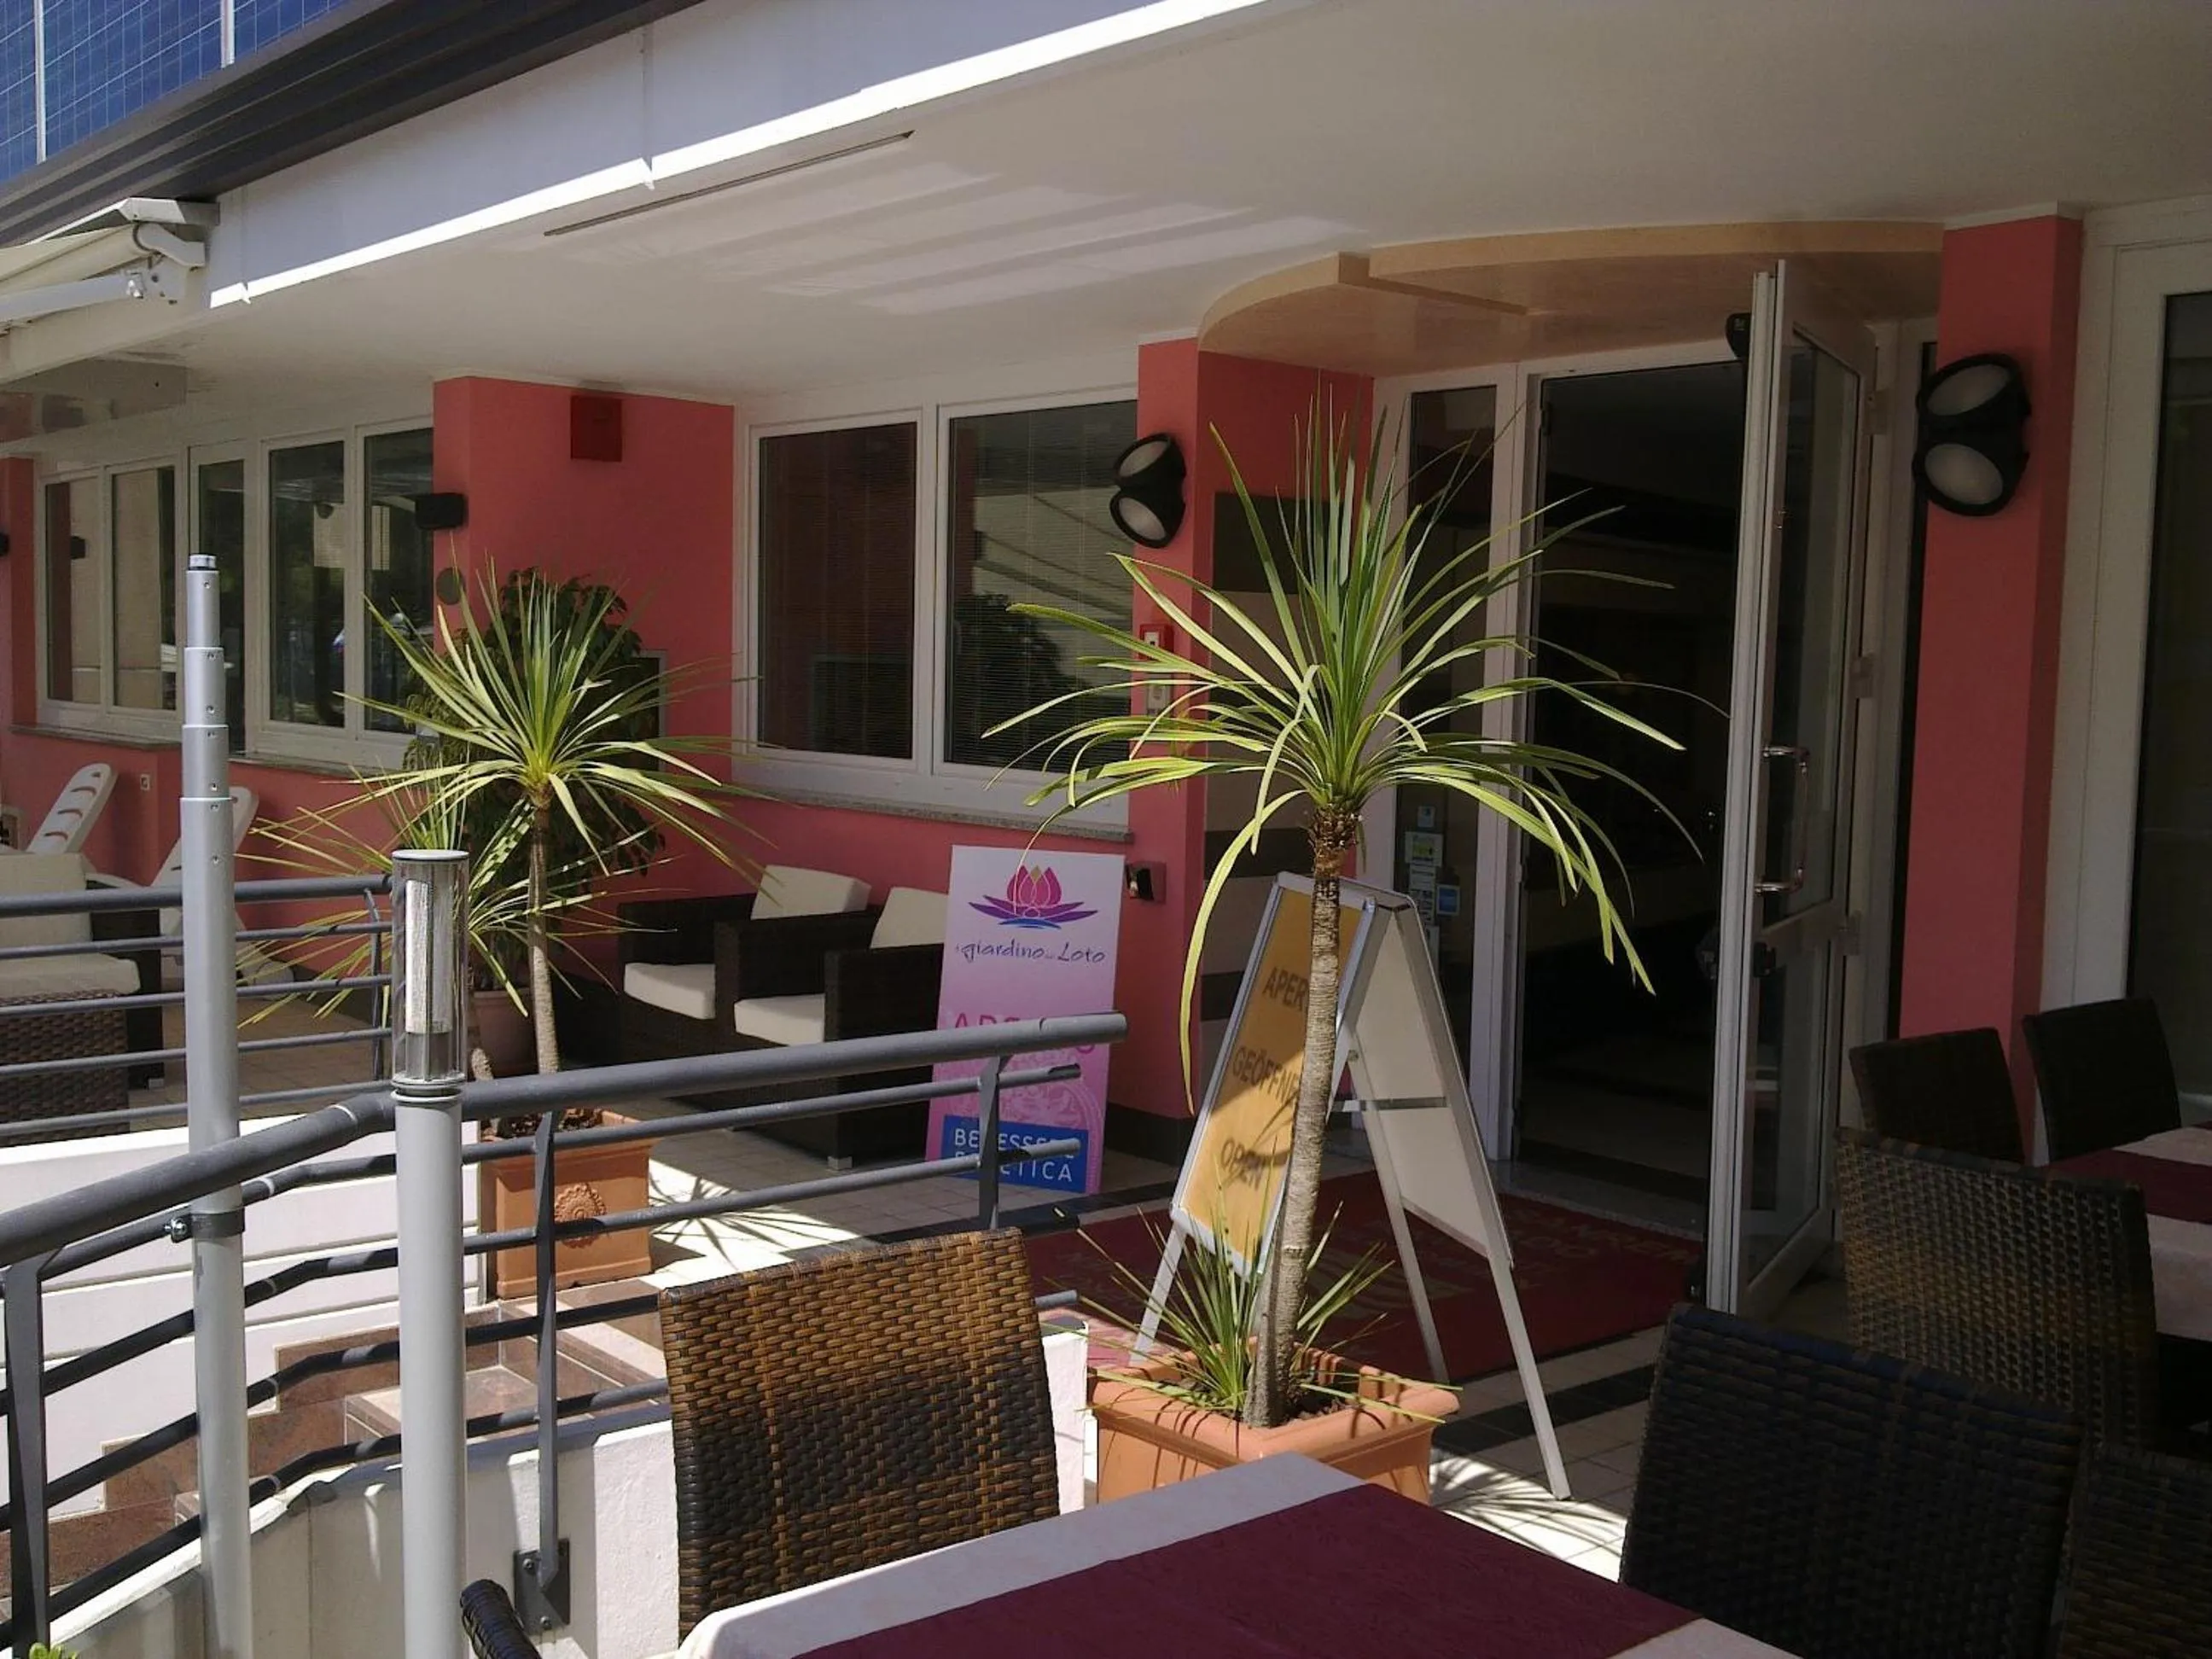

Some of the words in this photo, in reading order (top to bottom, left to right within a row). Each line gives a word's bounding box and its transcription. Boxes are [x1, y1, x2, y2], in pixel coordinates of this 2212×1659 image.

[962, 938, 1045, 963] giardino
[1057, 941, 1106, 963] Loto
[1262, 966, 1310, 1012] APER
[1233, 1046, 1299, 1103] GEÖFFNE
